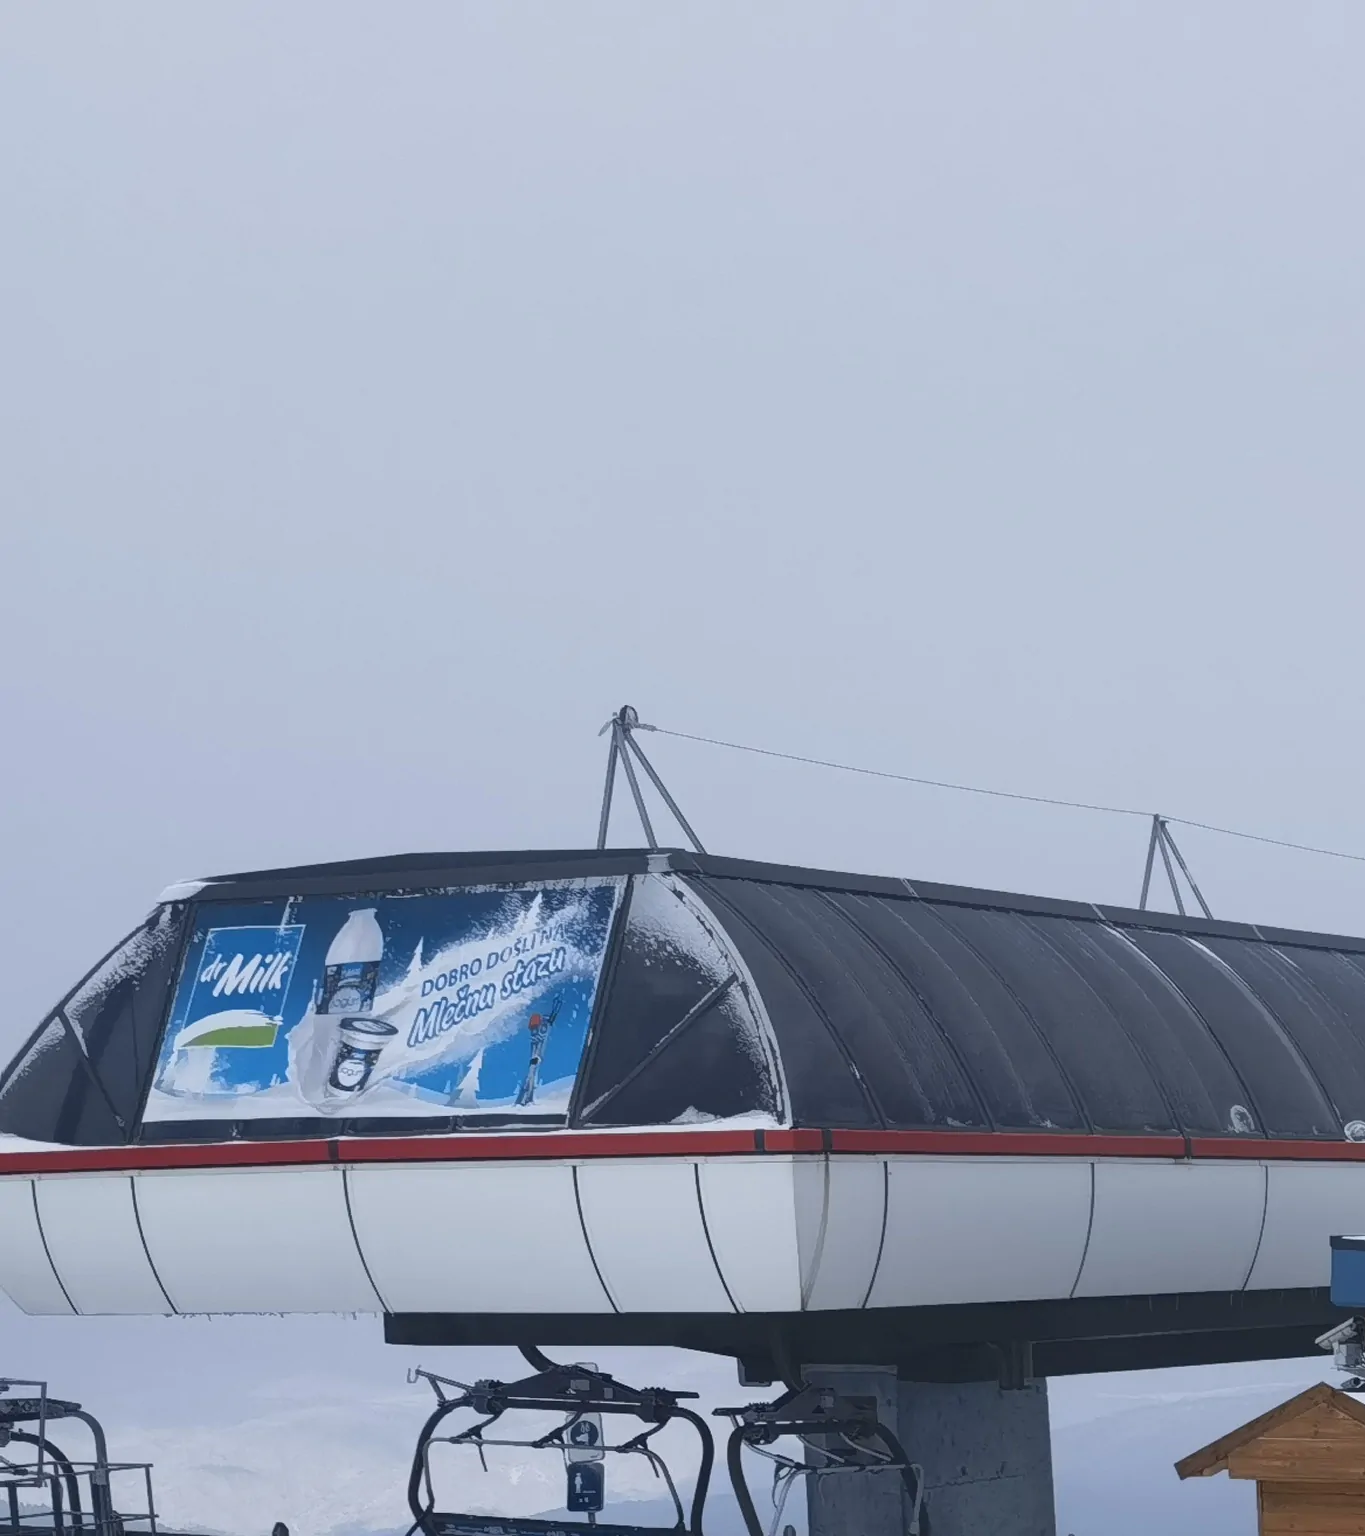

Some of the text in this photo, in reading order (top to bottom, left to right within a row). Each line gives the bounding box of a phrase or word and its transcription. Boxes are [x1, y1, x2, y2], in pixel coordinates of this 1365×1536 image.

[407, 946, 567, 1048] Mlečnu stazu
[421, 958, 482, 997] DOBRO
